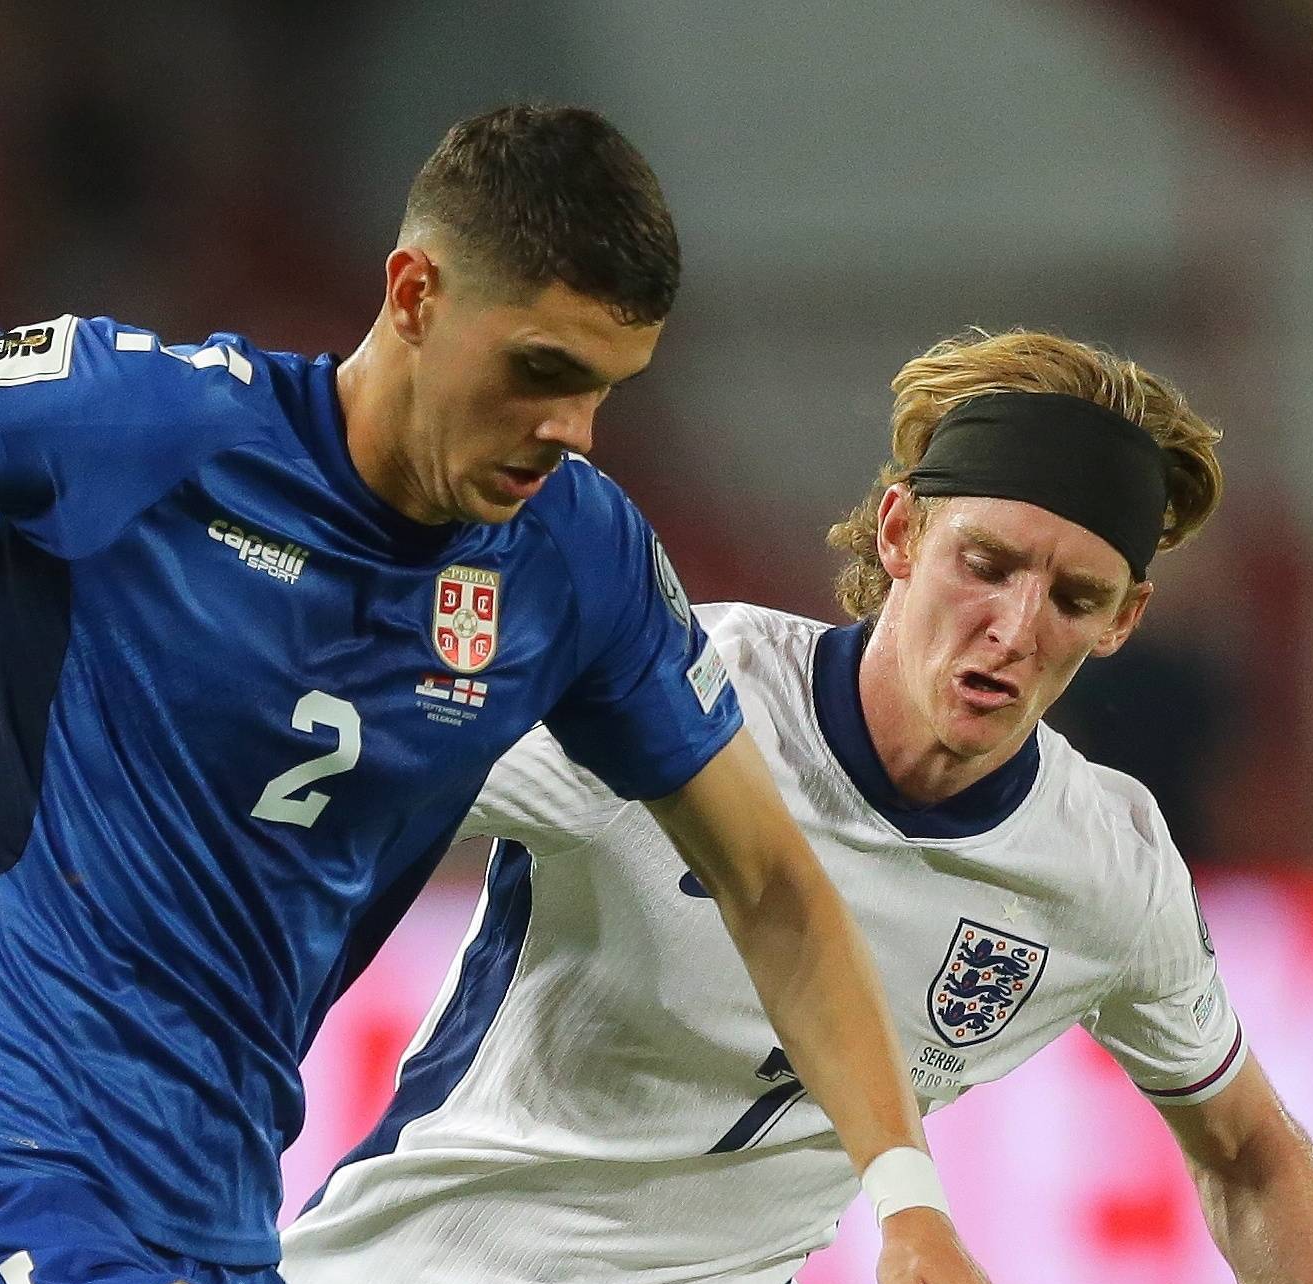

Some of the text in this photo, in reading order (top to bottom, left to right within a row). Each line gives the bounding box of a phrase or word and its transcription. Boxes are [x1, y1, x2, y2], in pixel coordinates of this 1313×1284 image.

[207, 519, 310, 576] capelli
[246, 556, 301, 585] SPORT
[249, 689, 362, 828] 2
[919, 1046, 966, 1074] SERBIA
